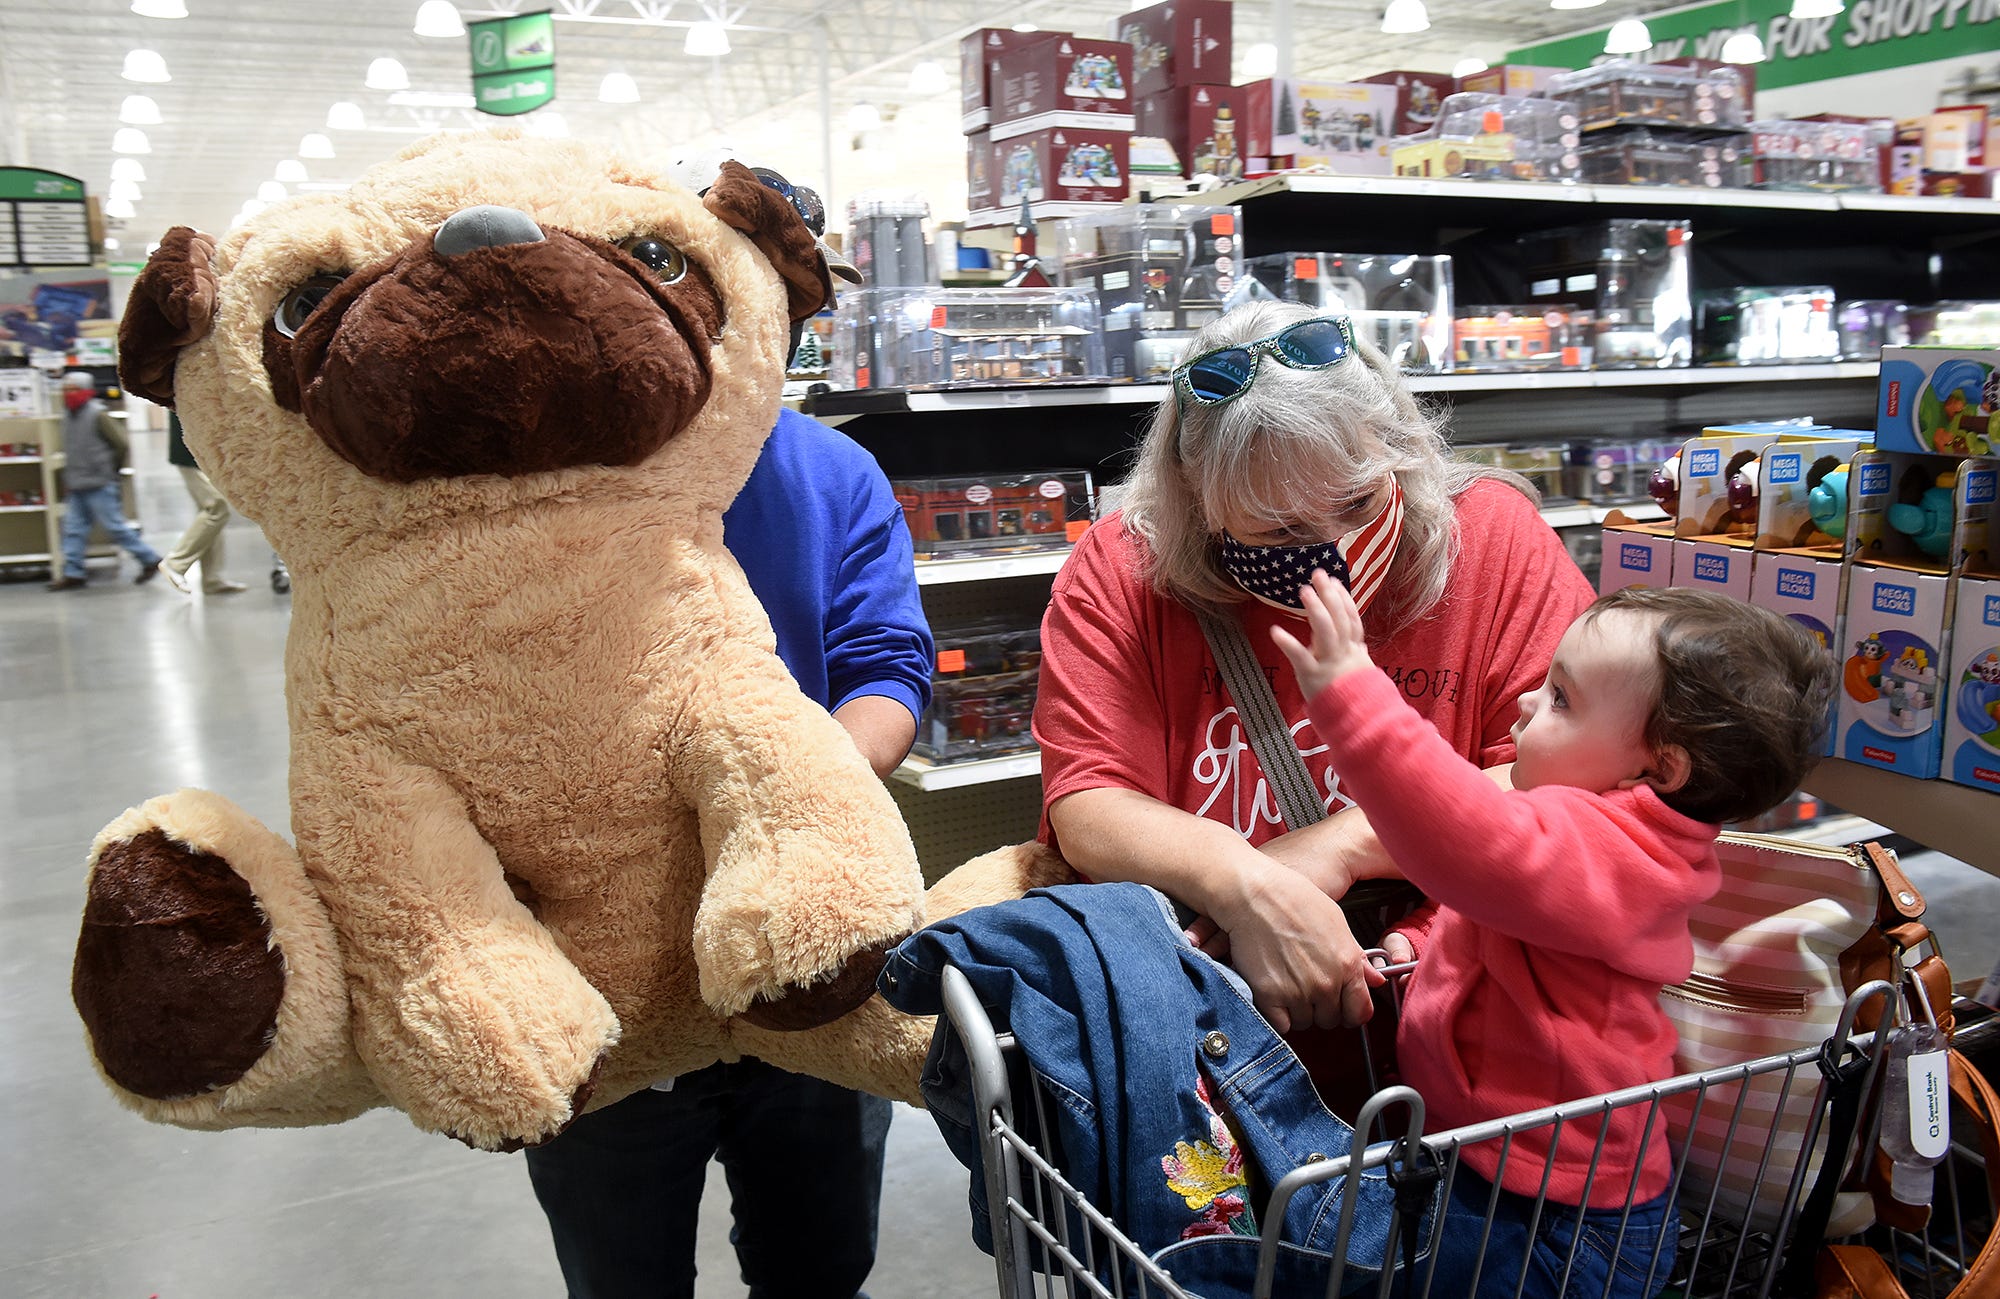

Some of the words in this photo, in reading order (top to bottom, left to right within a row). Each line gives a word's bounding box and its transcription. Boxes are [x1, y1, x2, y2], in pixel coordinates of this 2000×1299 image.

[1765, 13, 1836, 62] FOR
[1782, 573, 1811, 584] MEGA
[1780, 582, 1811, 596] BLOKS
[1877, 587, 1911, 601] MEGA
[1875, 597, 1911, 612] BLOKS
[1927, 1094, 1935, 1122] Central
